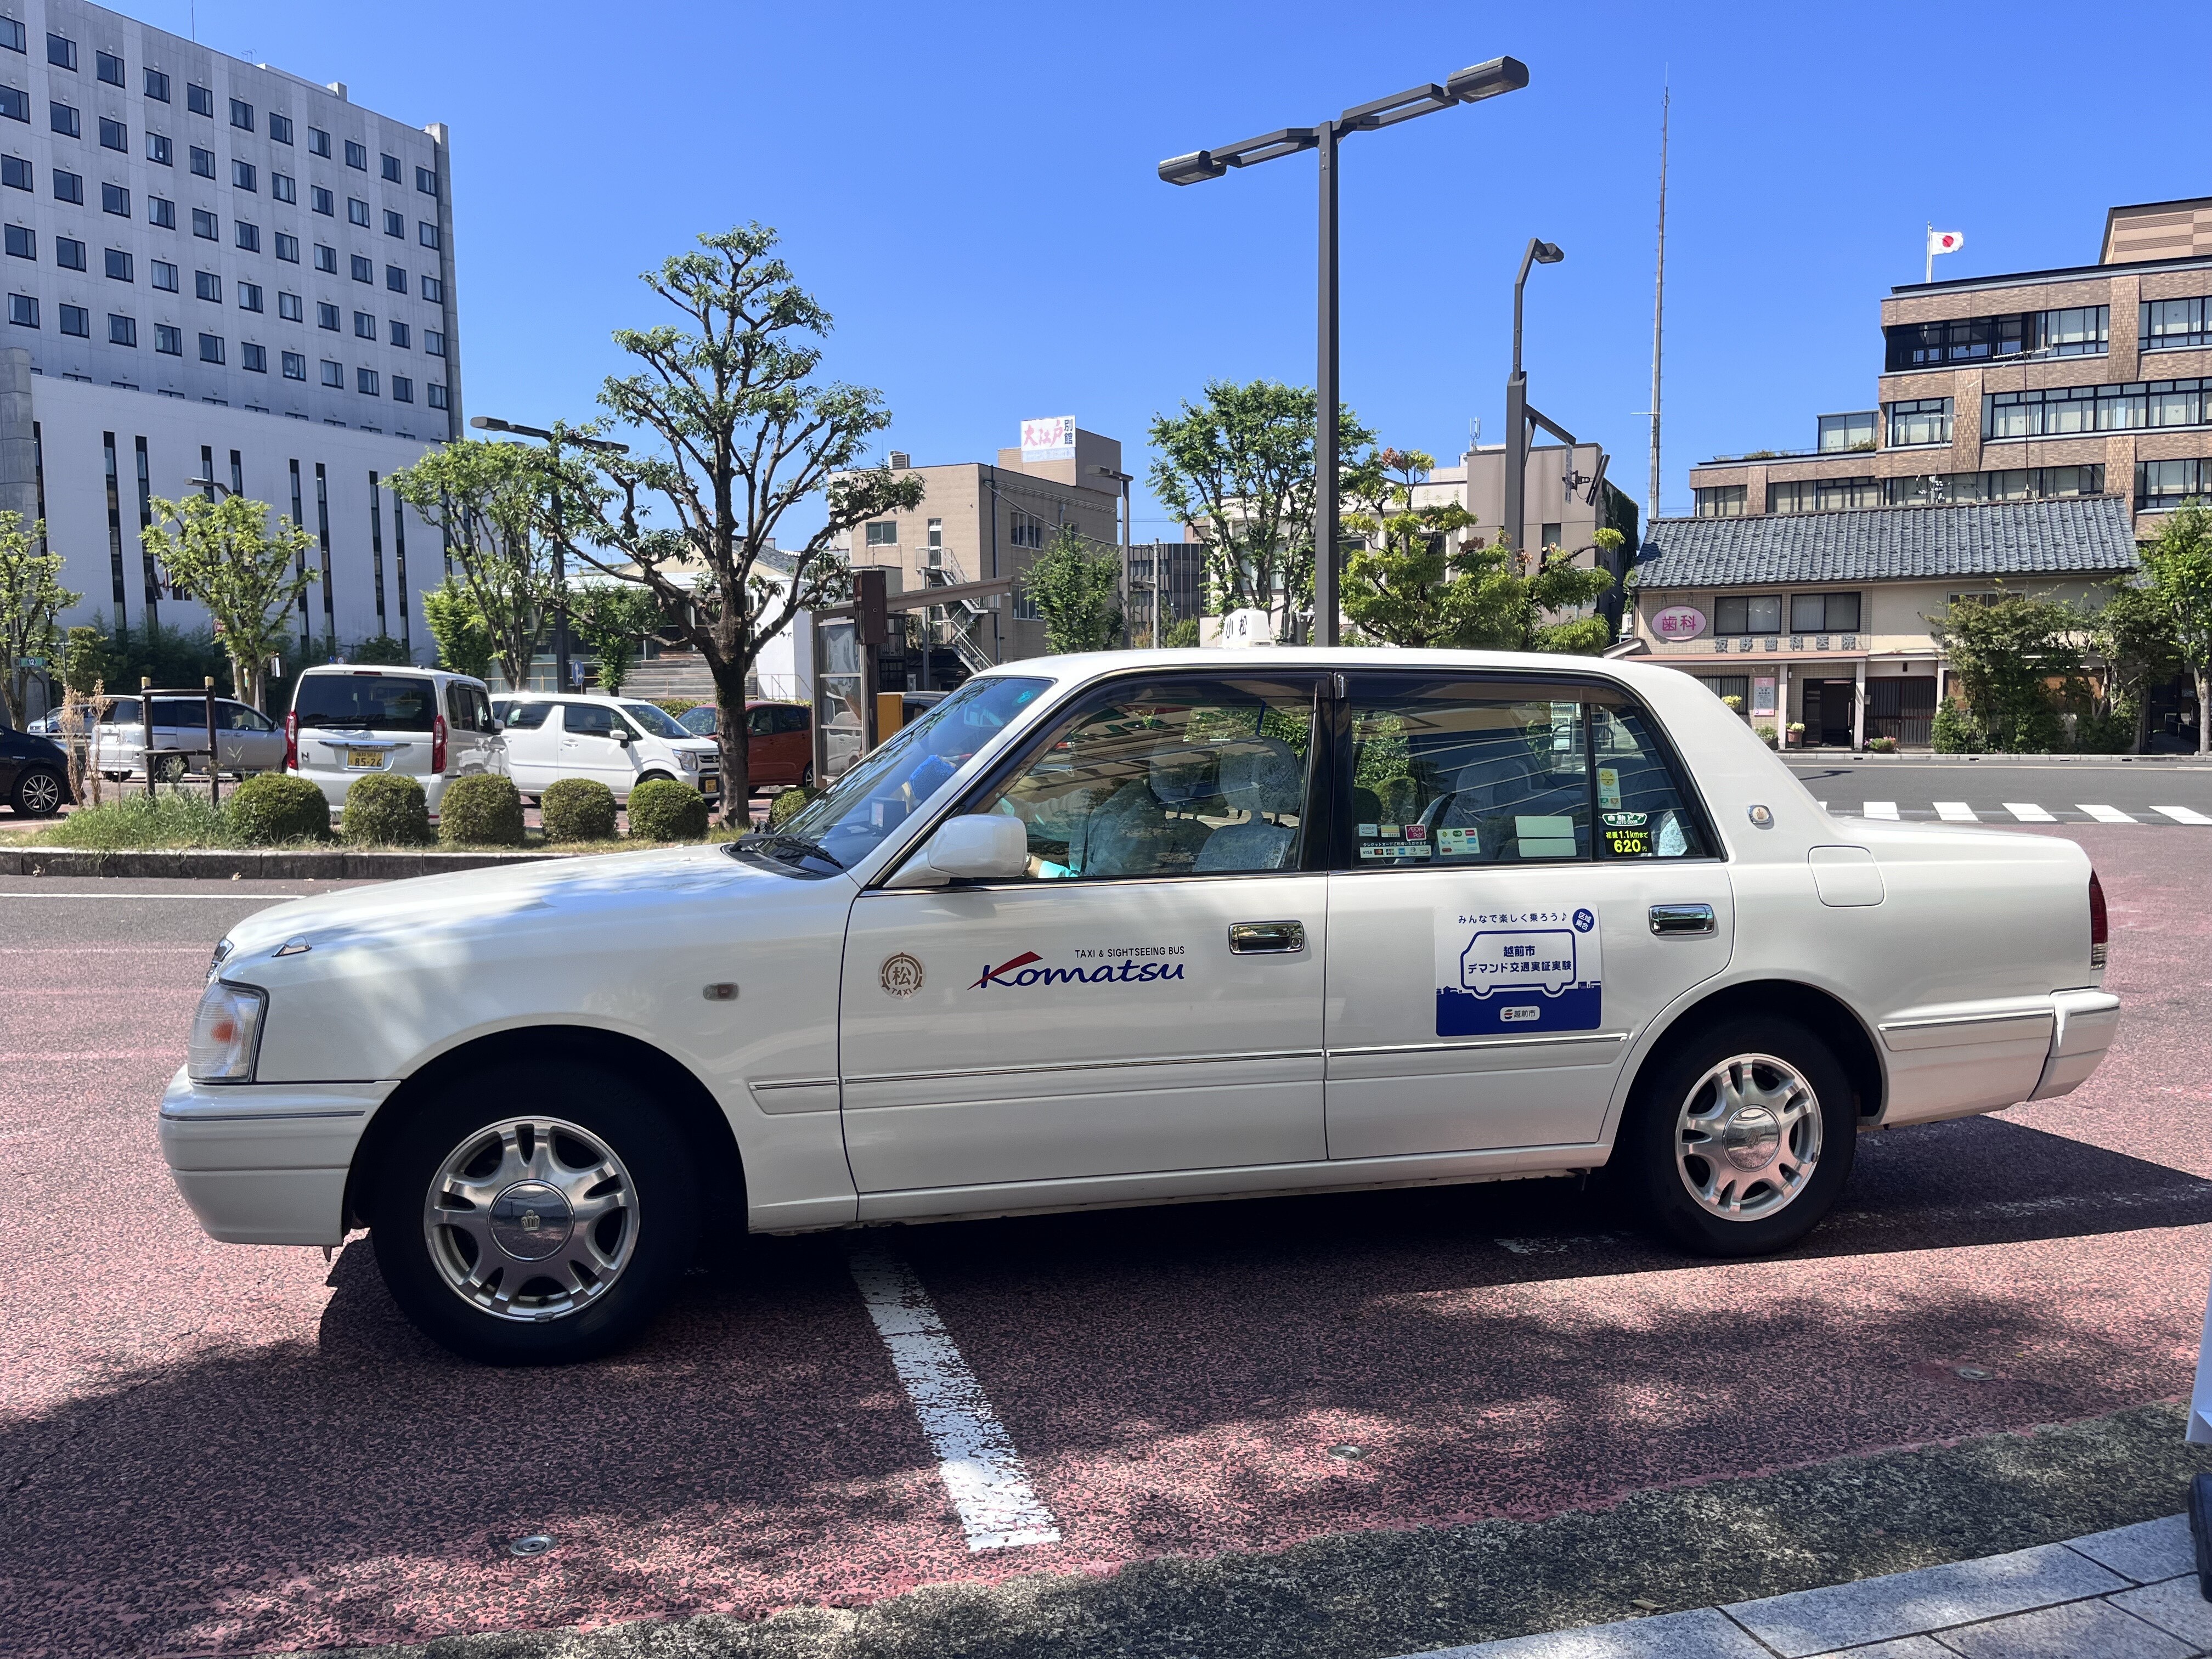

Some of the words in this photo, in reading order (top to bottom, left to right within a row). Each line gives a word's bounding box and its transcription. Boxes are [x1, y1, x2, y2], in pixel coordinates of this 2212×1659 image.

[1024, 419, 1063, 447] 大江戸
[1064, 419, 1073, 445] 別館
[1225, 615, 1248, 639] 小松
[1662, 615, 1696, 631] 歯科
[1715, 634, 1856, 652] 坂野歯科医院
[354, 758, 382, 767] 85-26
[1075, 950, 1096, 958] TAXI
[1107, 947, 1166, 957] SIGHTSEEING
[1168, 946, 1185, 955] BUS
[1503, 945, 1536, 957] 越前市
[968, 951, 1184, 989] Komatsu
[1468, 961, 1572, 974] デマンド交通実証実験
[891, 967, 912, 985] 松
[891, 988, 912, 996] TAXI
[1514, 1009, 1536, 1018] 越前市
